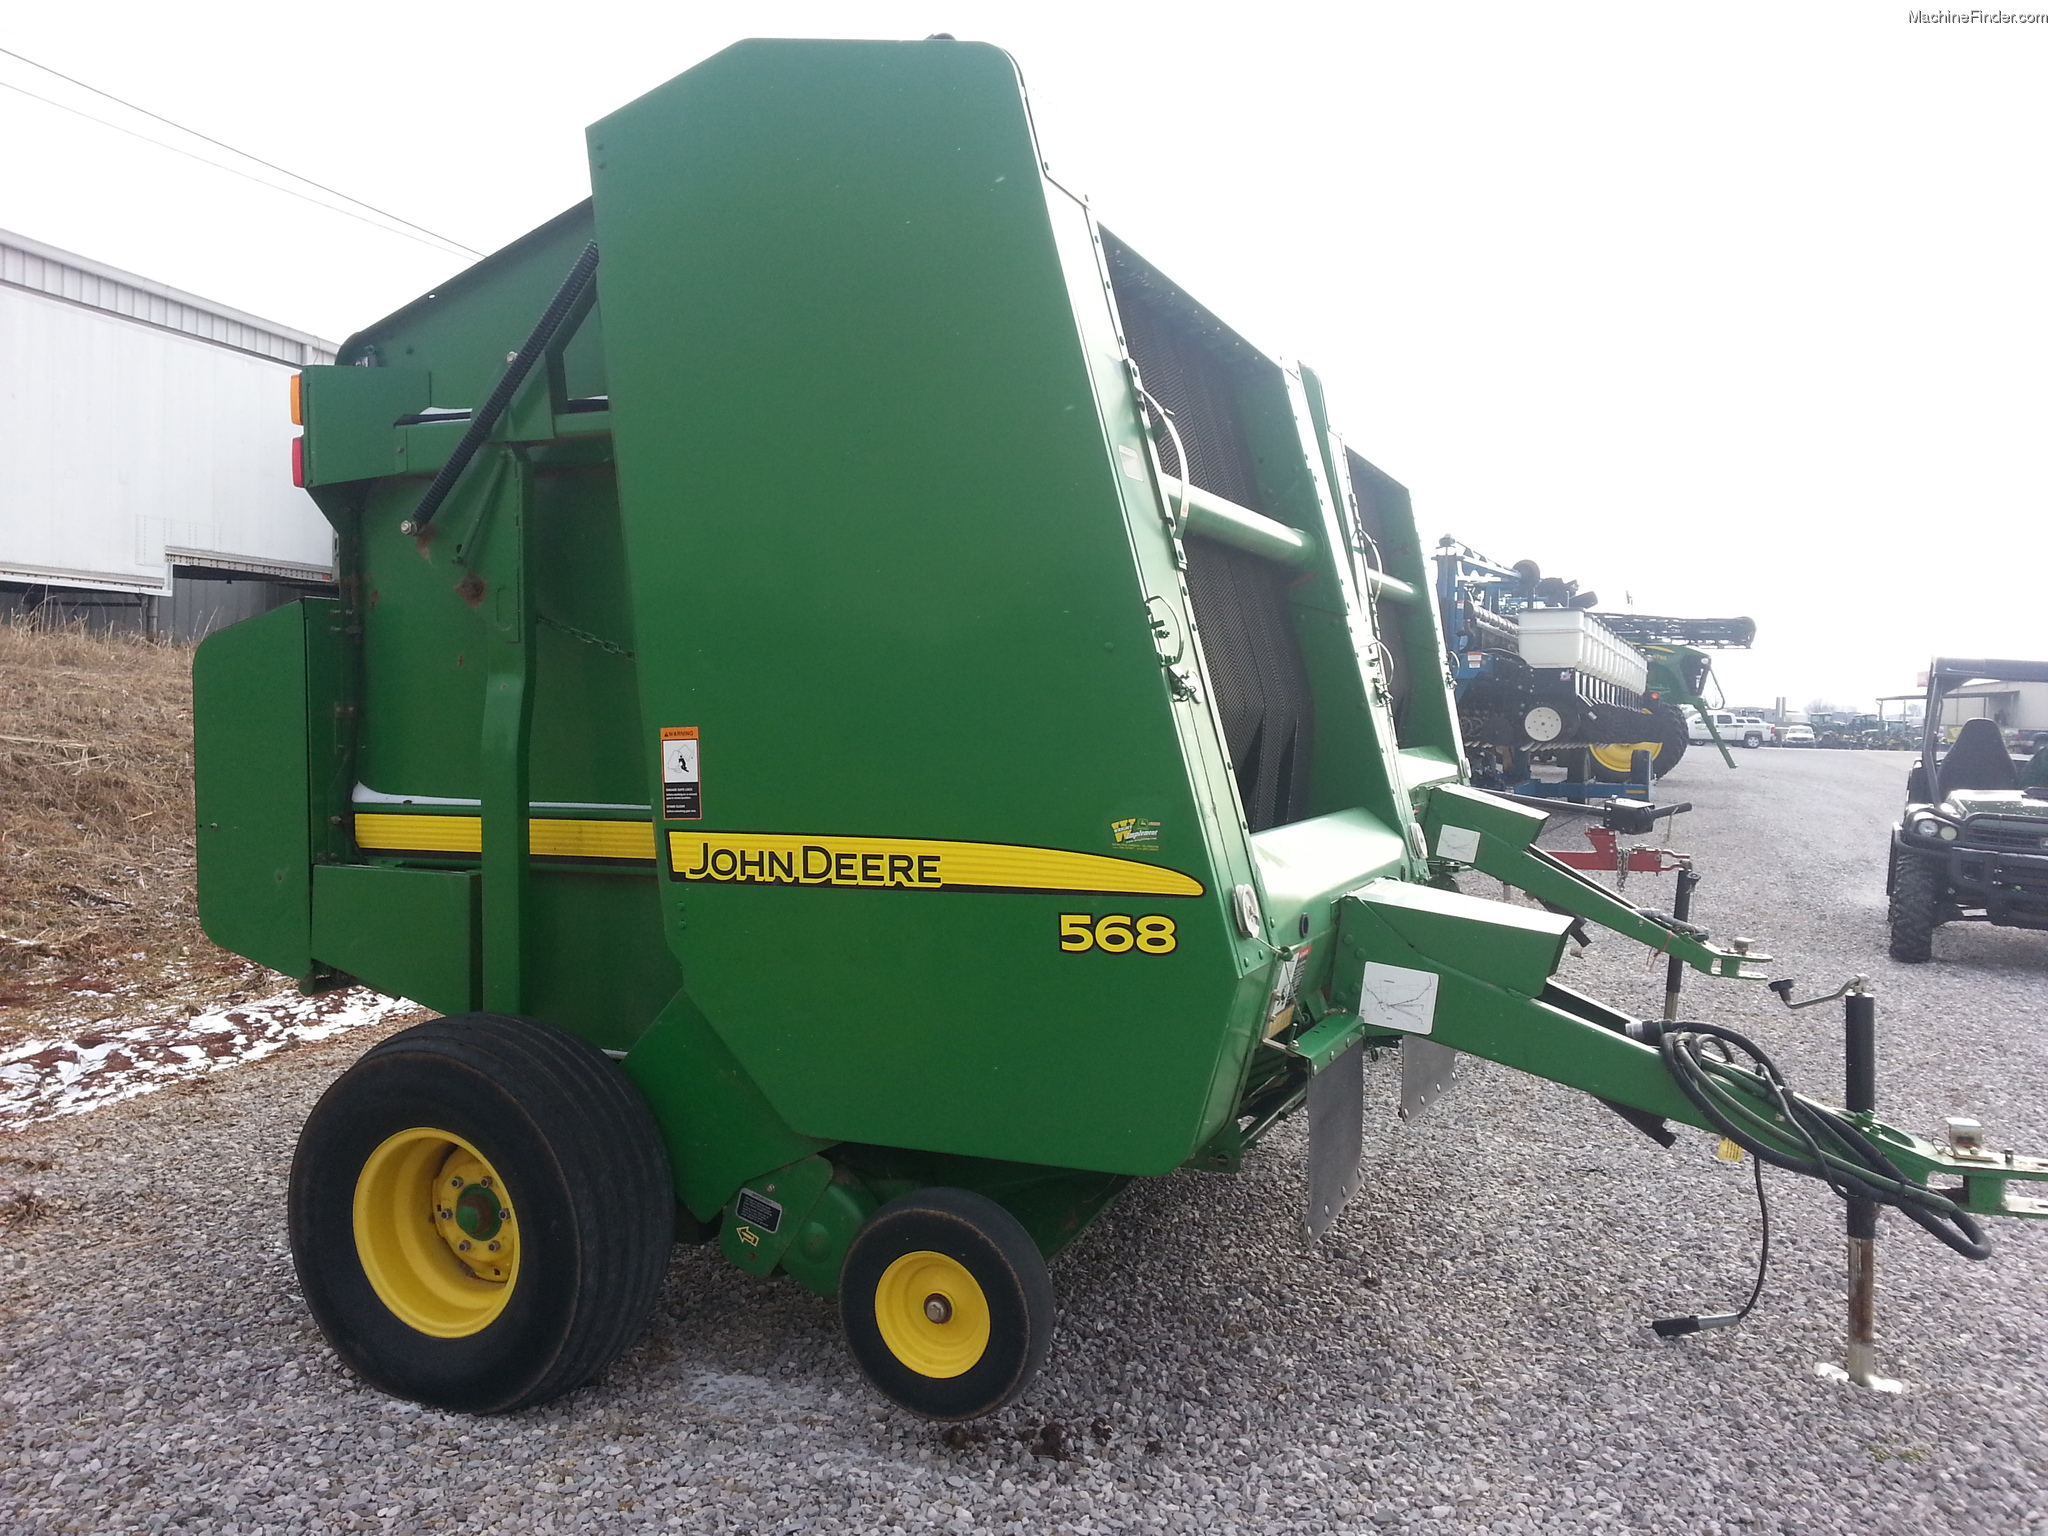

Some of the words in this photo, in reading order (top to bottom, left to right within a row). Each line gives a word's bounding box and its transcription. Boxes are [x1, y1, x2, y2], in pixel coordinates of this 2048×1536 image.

[687, 842, 795, 881] JOHN
[801, 845, 942, 886] DEERE
[1060, 913, 1177, 955] 568
